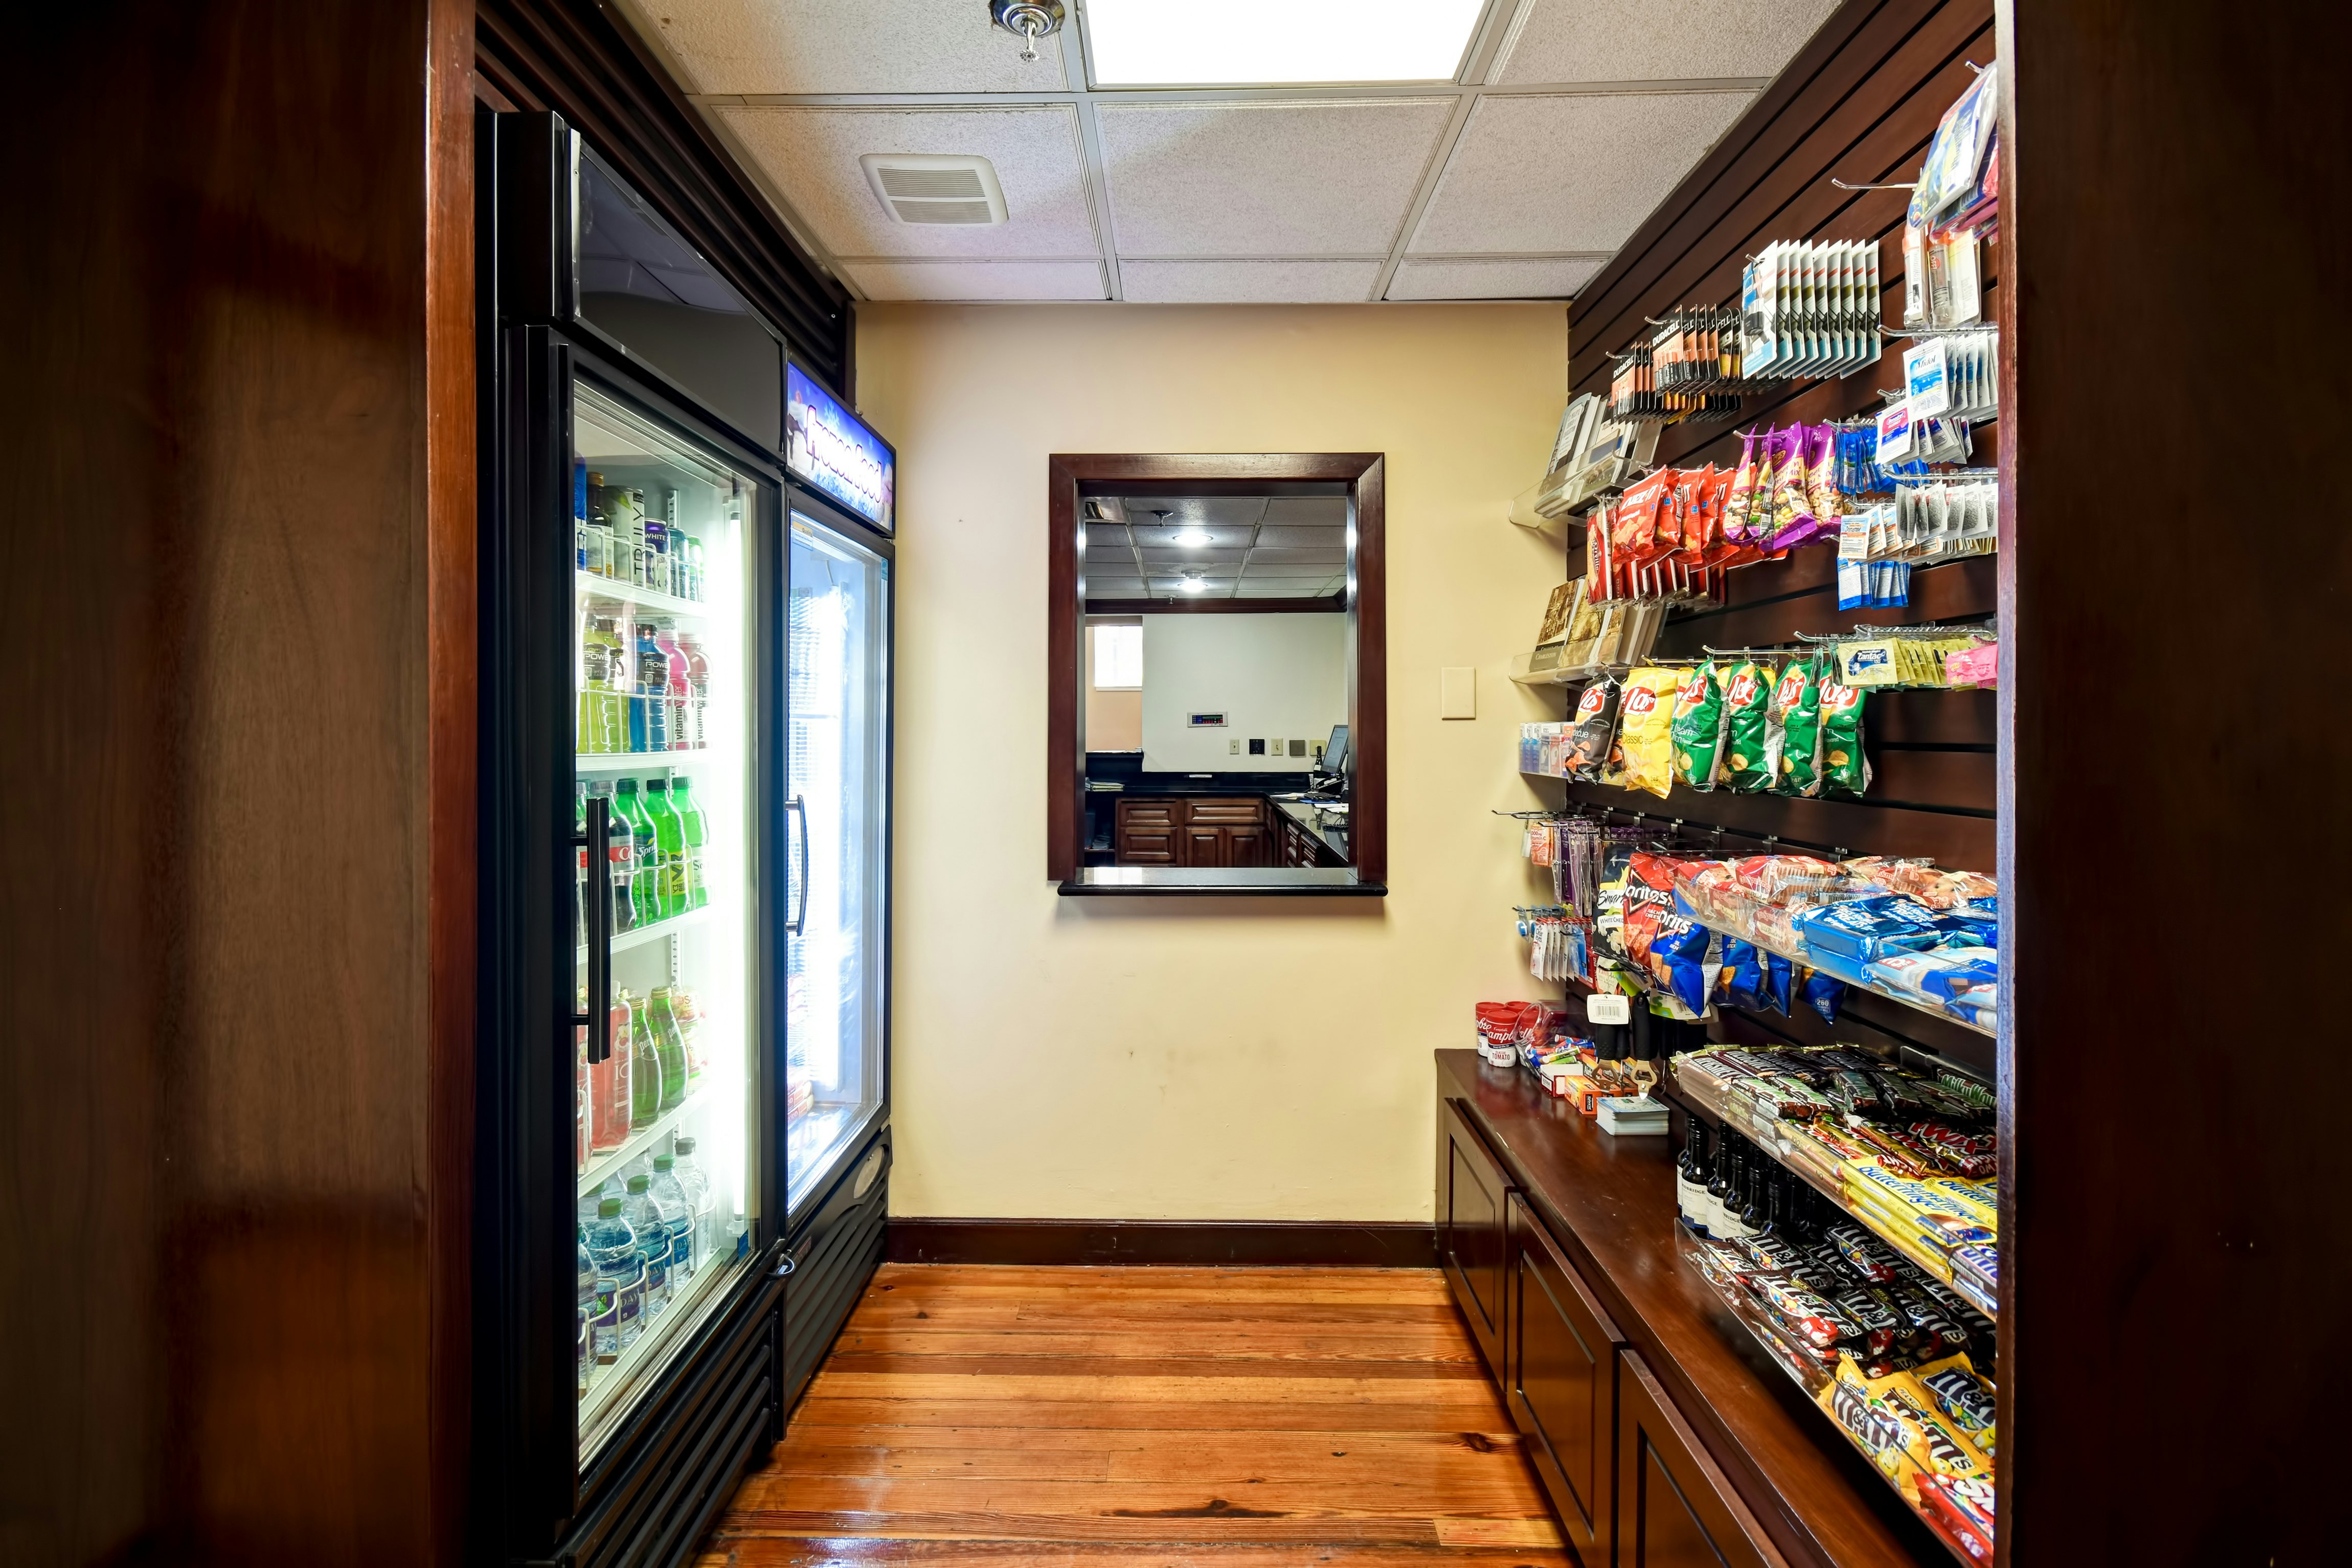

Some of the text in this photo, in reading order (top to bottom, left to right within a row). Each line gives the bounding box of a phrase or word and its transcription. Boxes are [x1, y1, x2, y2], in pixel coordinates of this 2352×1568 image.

[1653, 320, 1680, 347] DURACELL
[1613, 355, 1634, 379] DURACELL
[645, 533, 666, 541] WHITE
[1857, 652, 1881, 660] Zantac
[1908, 1122, 1989, 1155] TWIX
[1858, 1166, 1949, 1213] Butterfinger
[1898, 1388, 1923, 1410] PEANUT
